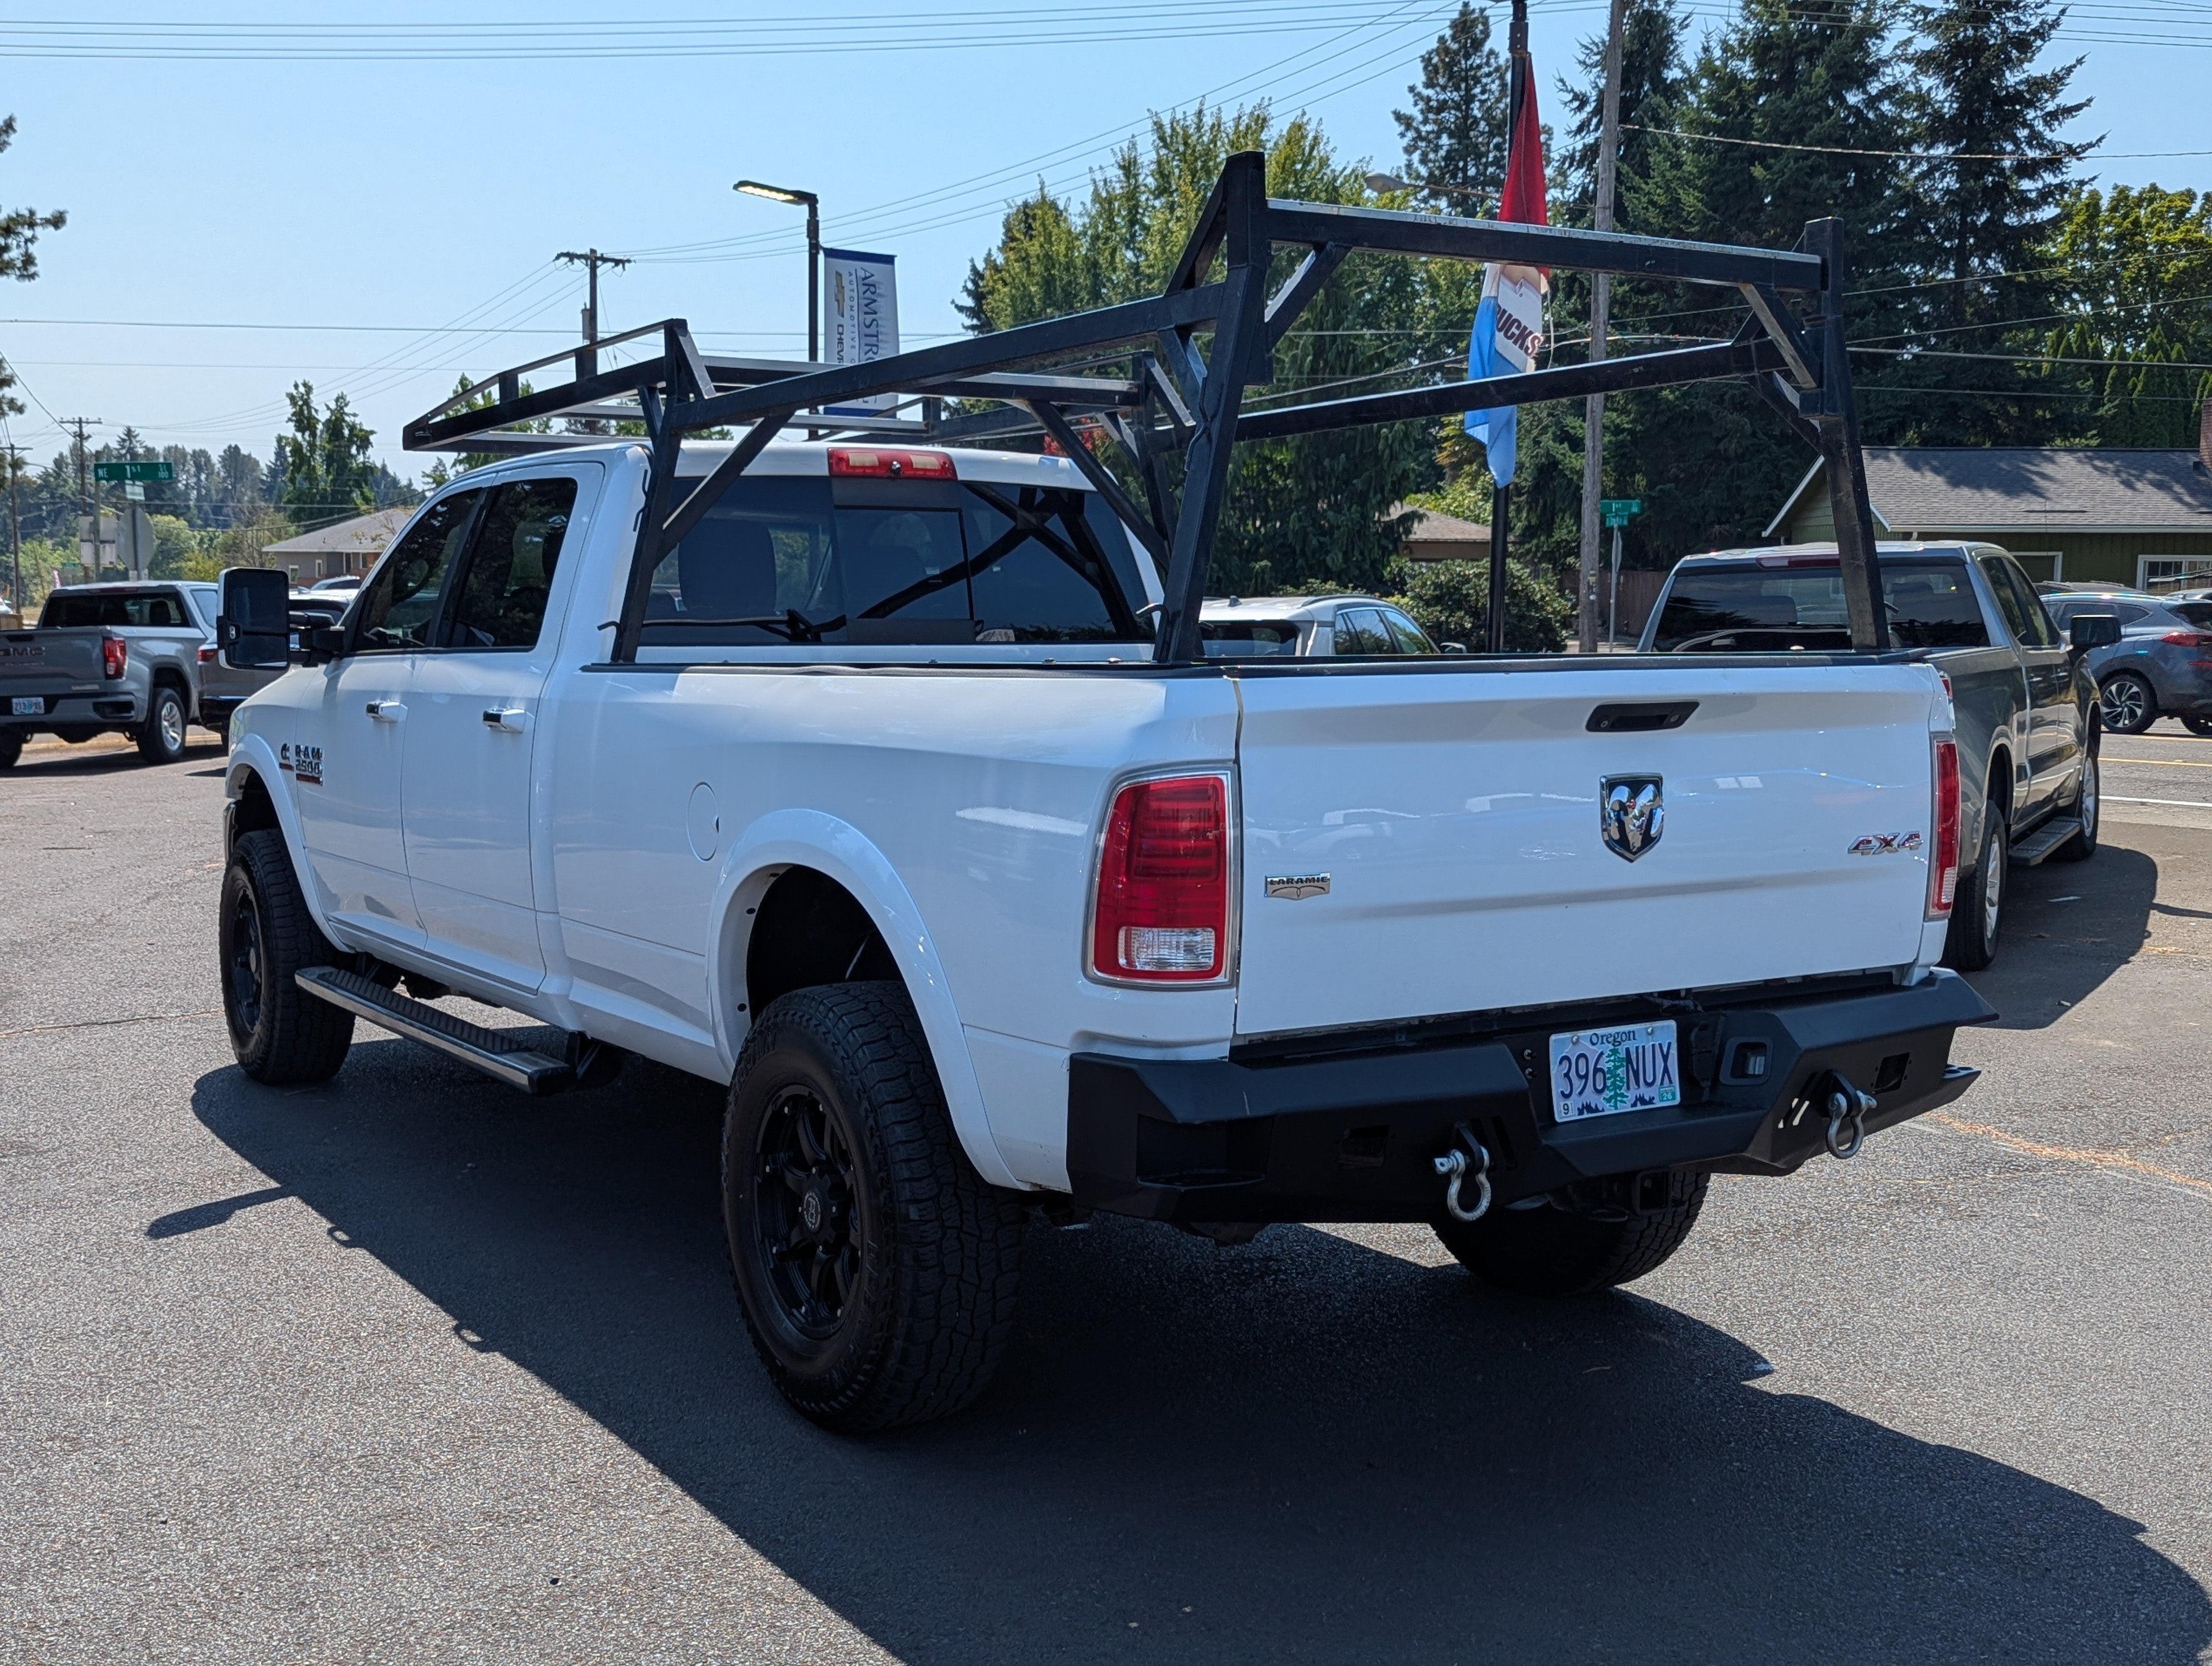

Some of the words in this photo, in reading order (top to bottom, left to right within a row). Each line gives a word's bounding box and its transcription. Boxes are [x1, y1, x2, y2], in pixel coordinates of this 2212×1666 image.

[848, 271, 856, 350] AUTOMOTIVE
[860, 267, 879, 404] ARMSTR
[837, 324, 845, 364] CHEVR
[98, 469, 108, 478] NE
[125, 465, 141, 478] 1st
[295, 745, 323, 760] RAM
[295, 759, 322, 774] 2500
[1269, 876, 1329, 886] LARAMIE
[1589, 1029, 1637, 1047] Oregon
[1559, 1050, 1607, 1099] 396
[1625, 1041, 1674, 1091] NUX
[1662, 1092, 1673, 1100] 26
[1562, 1103, 1570, 1115] 9
